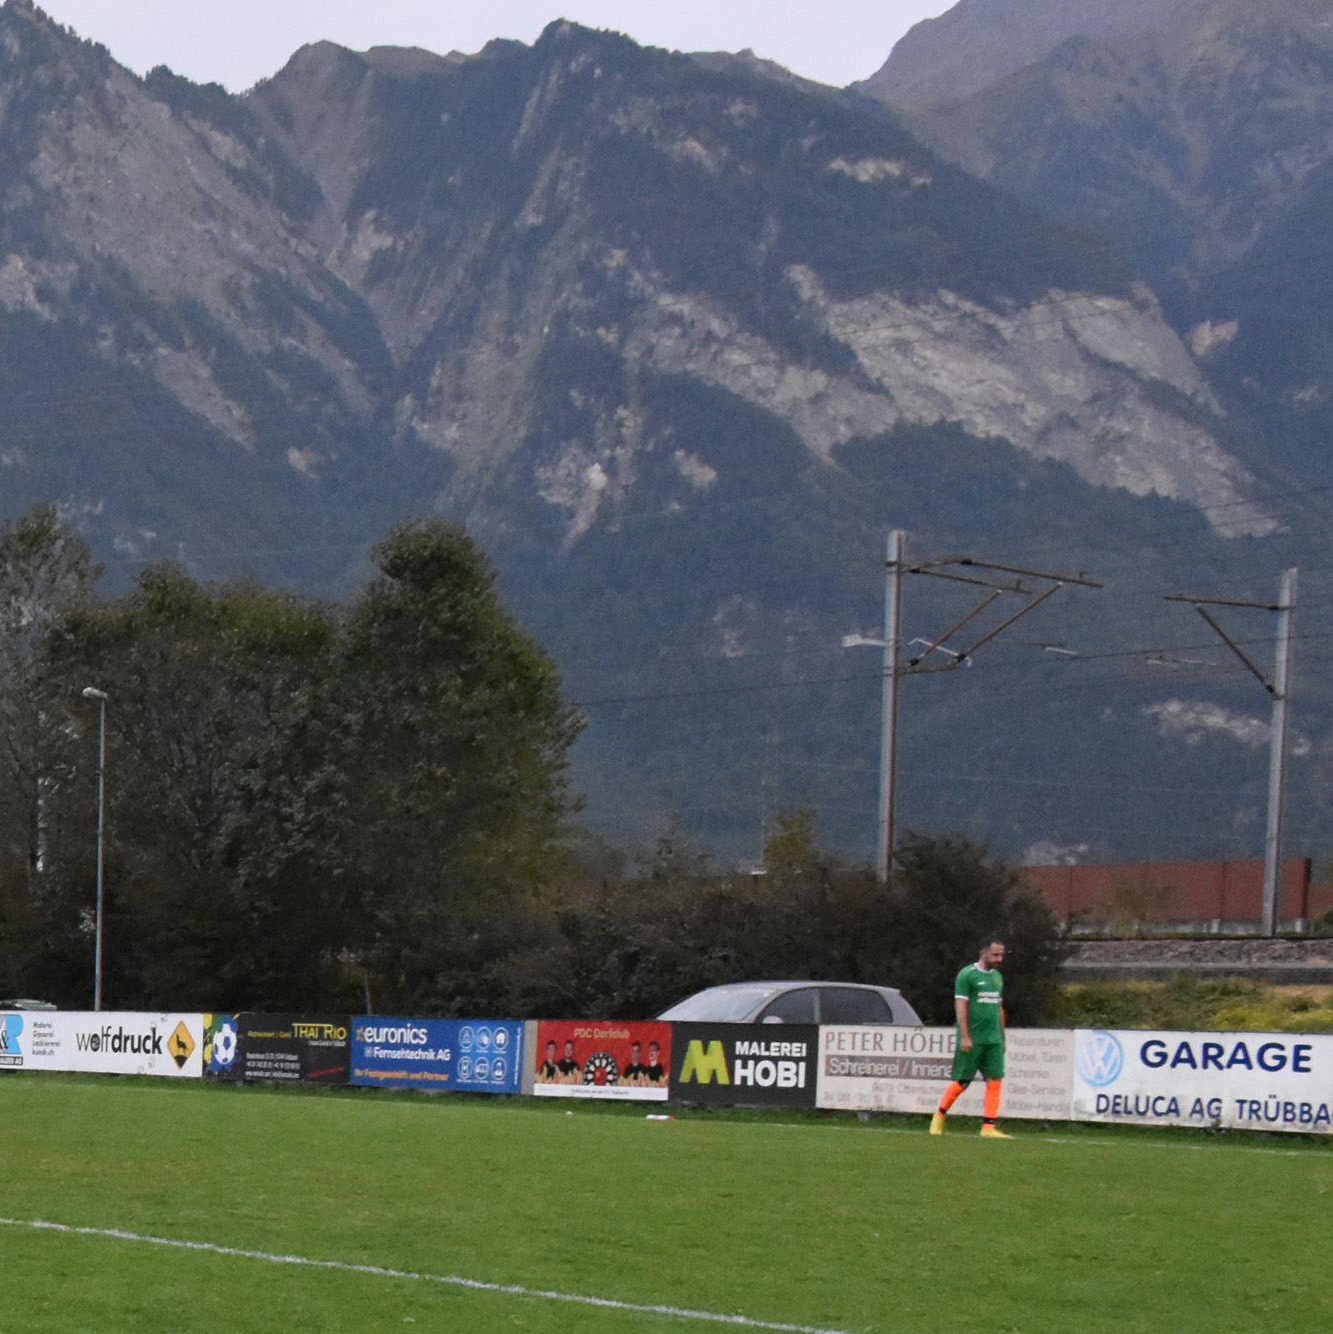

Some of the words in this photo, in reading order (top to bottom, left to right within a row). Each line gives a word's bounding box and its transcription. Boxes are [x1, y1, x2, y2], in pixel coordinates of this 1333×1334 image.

[76, 1026, 163, 1055] wolfdruck
[293, 1022, 321, 1039] THAI
[364, 1023, 428, 1045] euronics
[825, 1032, 884, 1051] PETER
[893, 1028, 956, 1053] HÖHE
[436, 1049, 451, 1061] AG
[735, 1041, 807, 1057] MALEREI
[1140, 1039, 1313, 1073] GARAGE
[734, 1059, 806, 1088] HOBI
[829, 1057, 899, 1076] Schreinerei
[911, 1060, 952, 1077] Innena
[1095, 1093, 1180, 1117] DELUCA
[1189, 1097, 1223, 1119] AG
[1235, 1094, 1333, 1125] TRÜBBA
